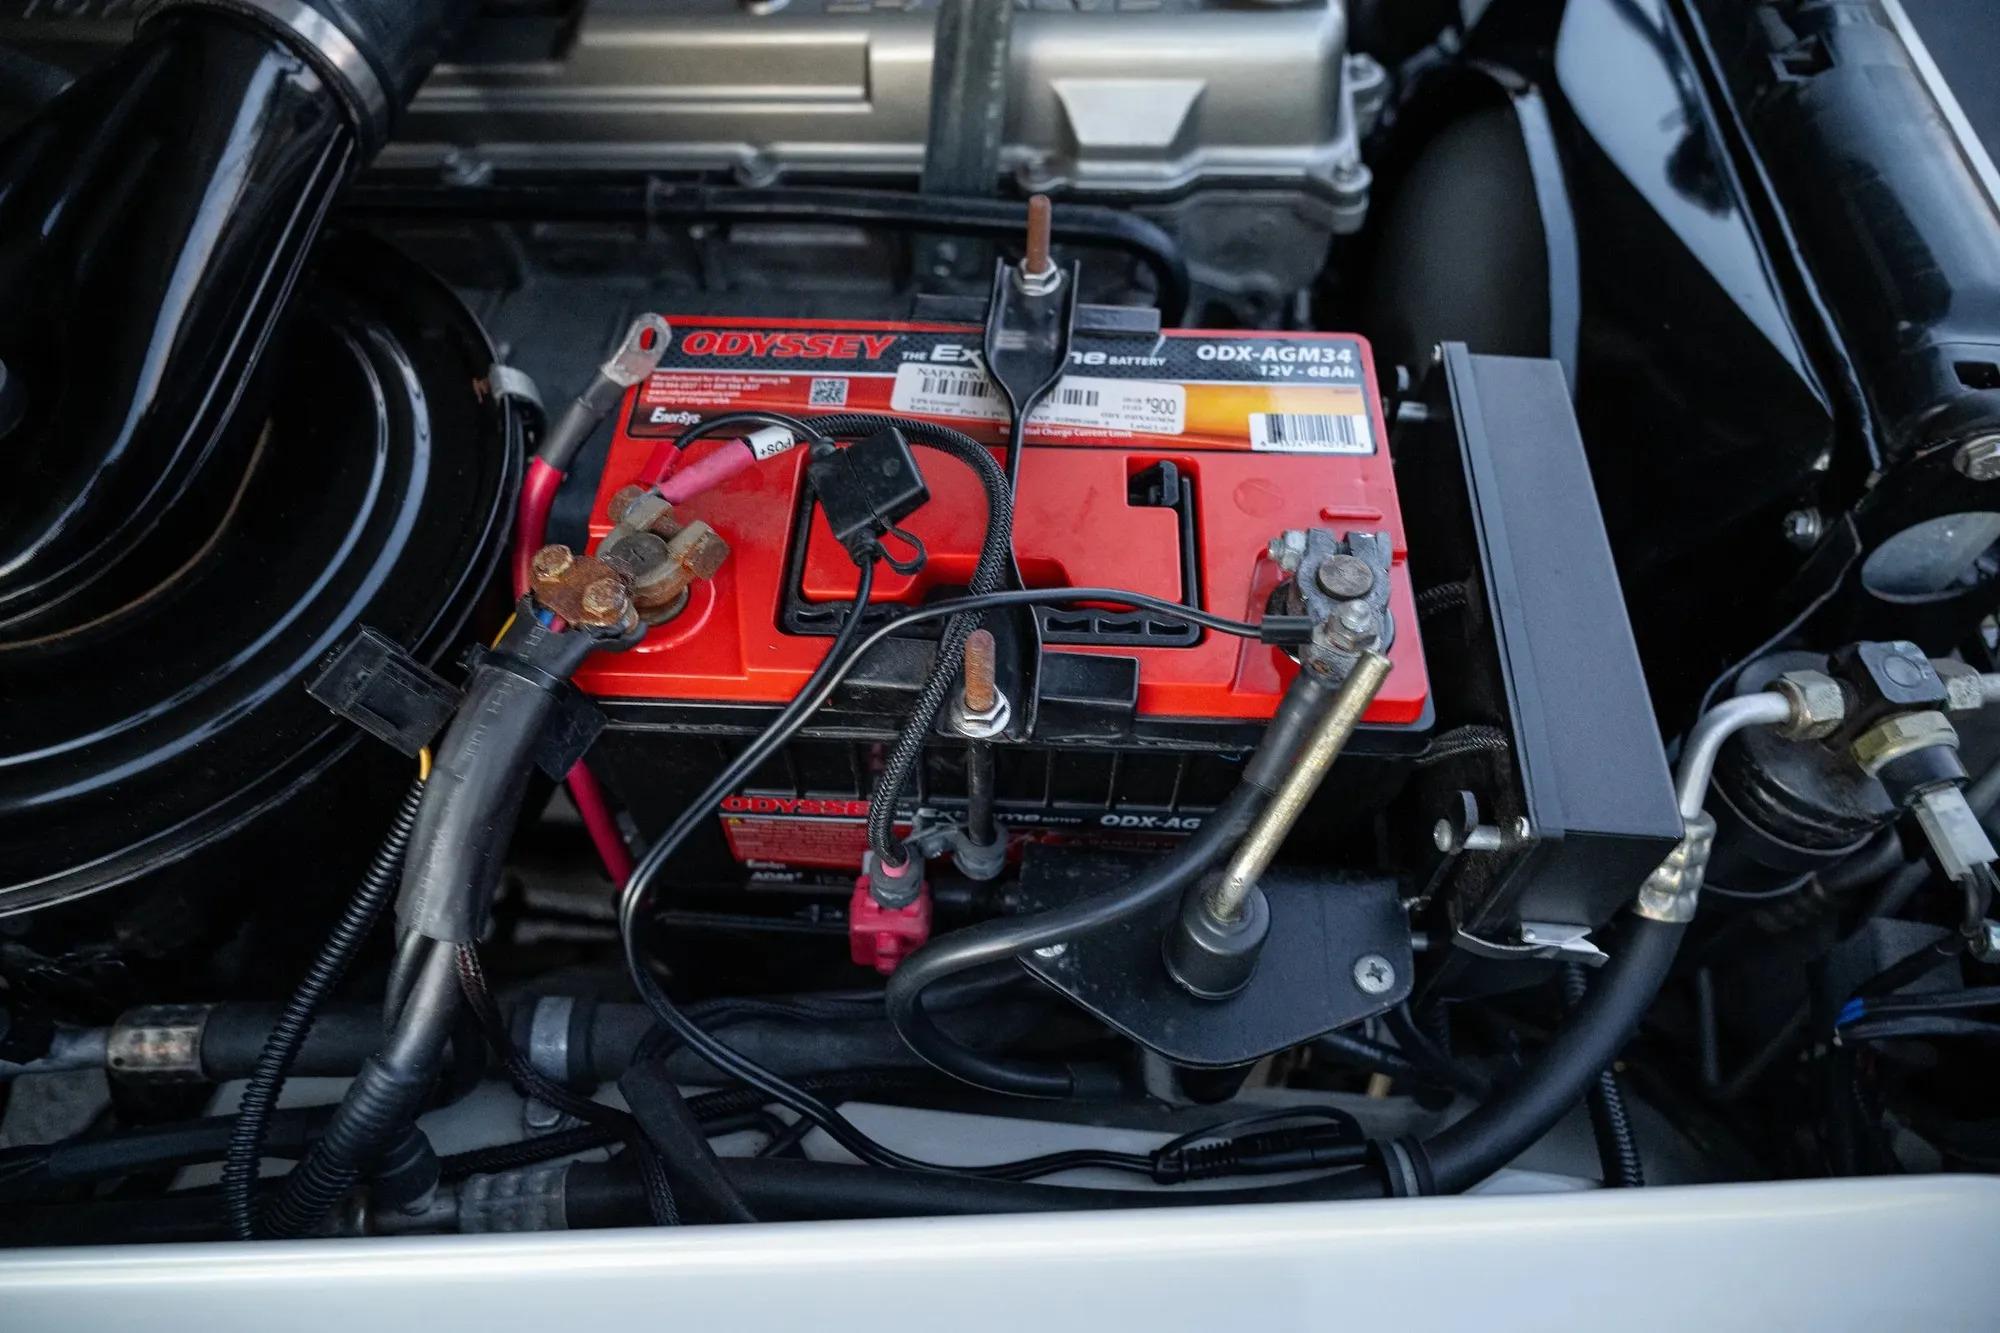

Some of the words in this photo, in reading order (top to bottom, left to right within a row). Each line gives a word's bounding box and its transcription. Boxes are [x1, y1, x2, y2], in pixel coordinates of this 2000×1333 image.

[681, 331, 897, 359] ODYSSEY
[902, 351, 928, 360] THE
[1109, 355, 1166, 366] BATTERY
[1197, 344, 1352, 364] ODX-AGM34
[917, 367, 955, 378] NAPA
[1260, 365, 1294, 377] 12V
[1307, 366, 1354, 378] 68Ah
[650, 407, 701, 425] EnerSys
[1042, 428, 1073, 438] Charge
[1074, 429, 1108, 438] Current
[721, 796, 871, 816] ODYSSE
